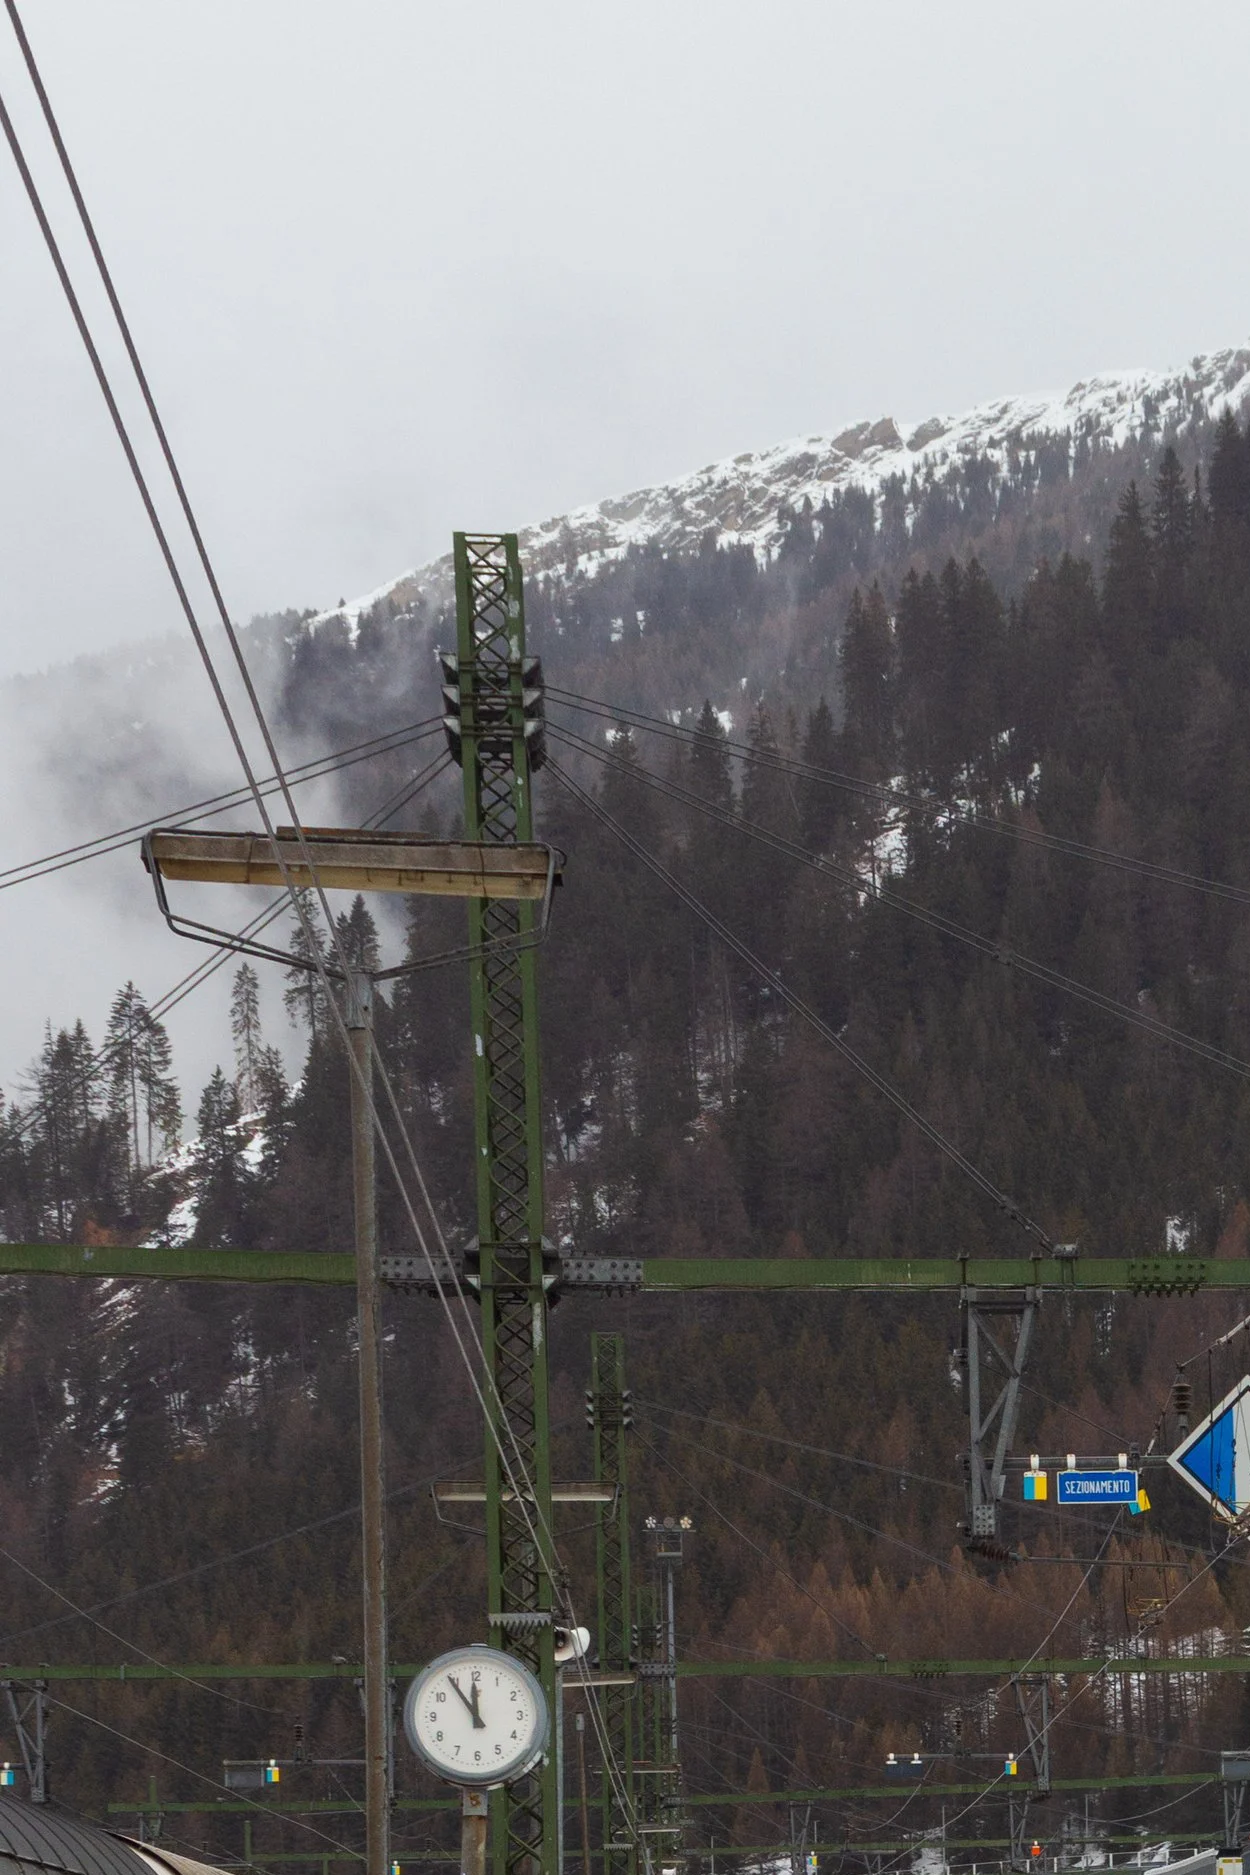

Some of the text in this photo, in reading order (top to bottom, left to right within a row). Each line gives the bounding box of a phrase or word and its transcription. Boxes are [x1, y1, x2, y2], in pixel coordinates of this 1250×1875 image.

[1064, 1479, 1131, 1495] SEZIONAMENTO
[471, 1671, 481, 1682] 12
[436, 1692, 447, 1702] 10
[510, 1691, 517, 1701] 2
[430, 1712, 437, 1722] 9
[516, 1710, 523, 1720] 3
[436, 1731, 444, 1741] 8
[510, 1730, 518, 1740] 4
[453, 1745, 461, 1756] 7
[495, 1744, 502, 1755] 5
[474, 1751, 481, 1761] 6
